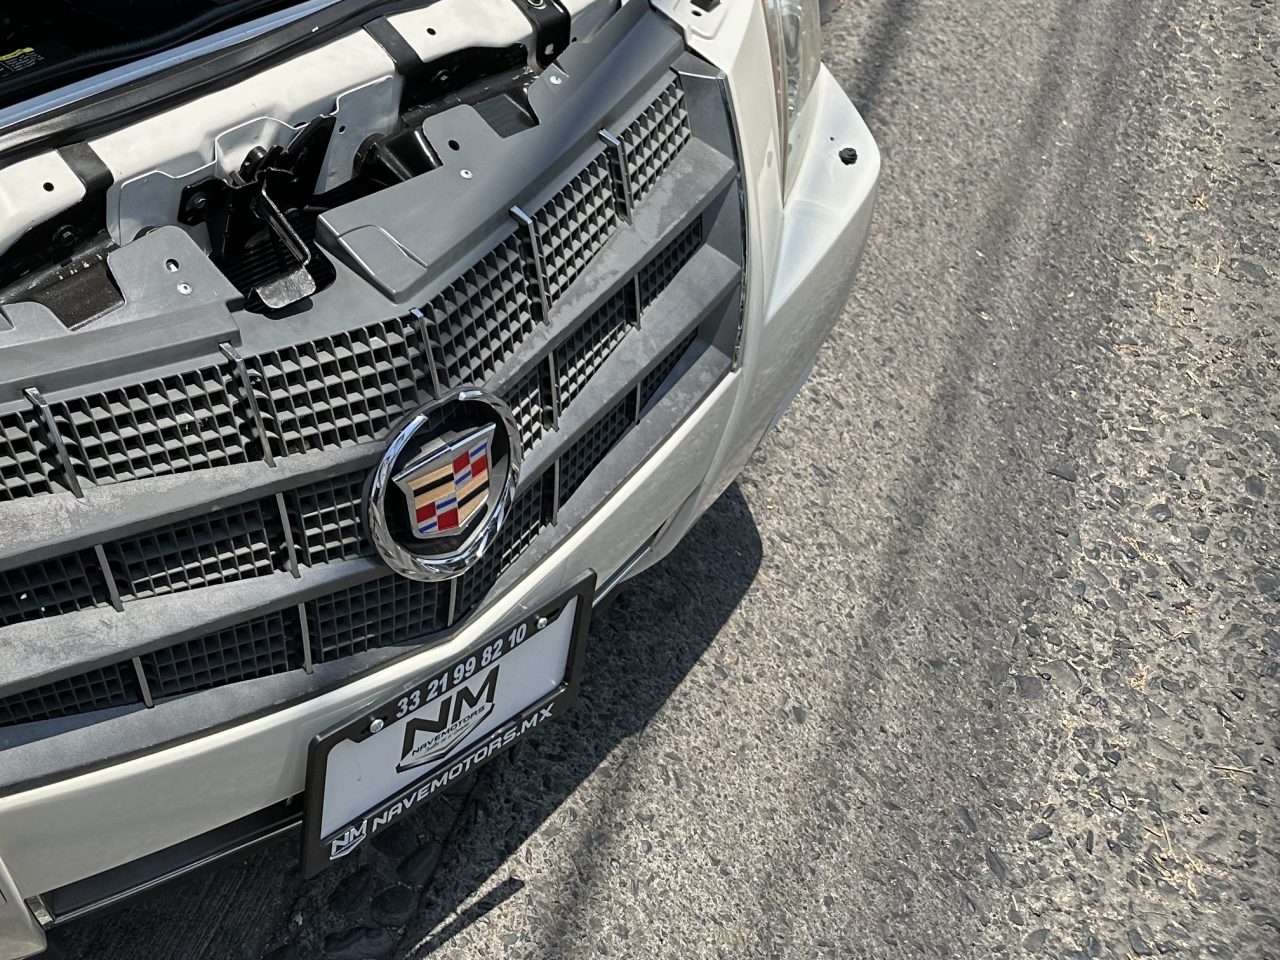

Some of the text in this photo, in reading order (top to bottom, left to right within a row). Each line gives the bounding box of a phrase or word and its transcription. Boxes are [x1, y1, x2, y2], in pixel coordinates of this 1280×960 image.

[396, 623, 527, 718] 33 21 99 82 10
[401, 664, 500, 761] NM
[372, 702, 555, 833] NAVEMOTORS.MX
[412, 704, 486, 757] NAVEMOTORS
